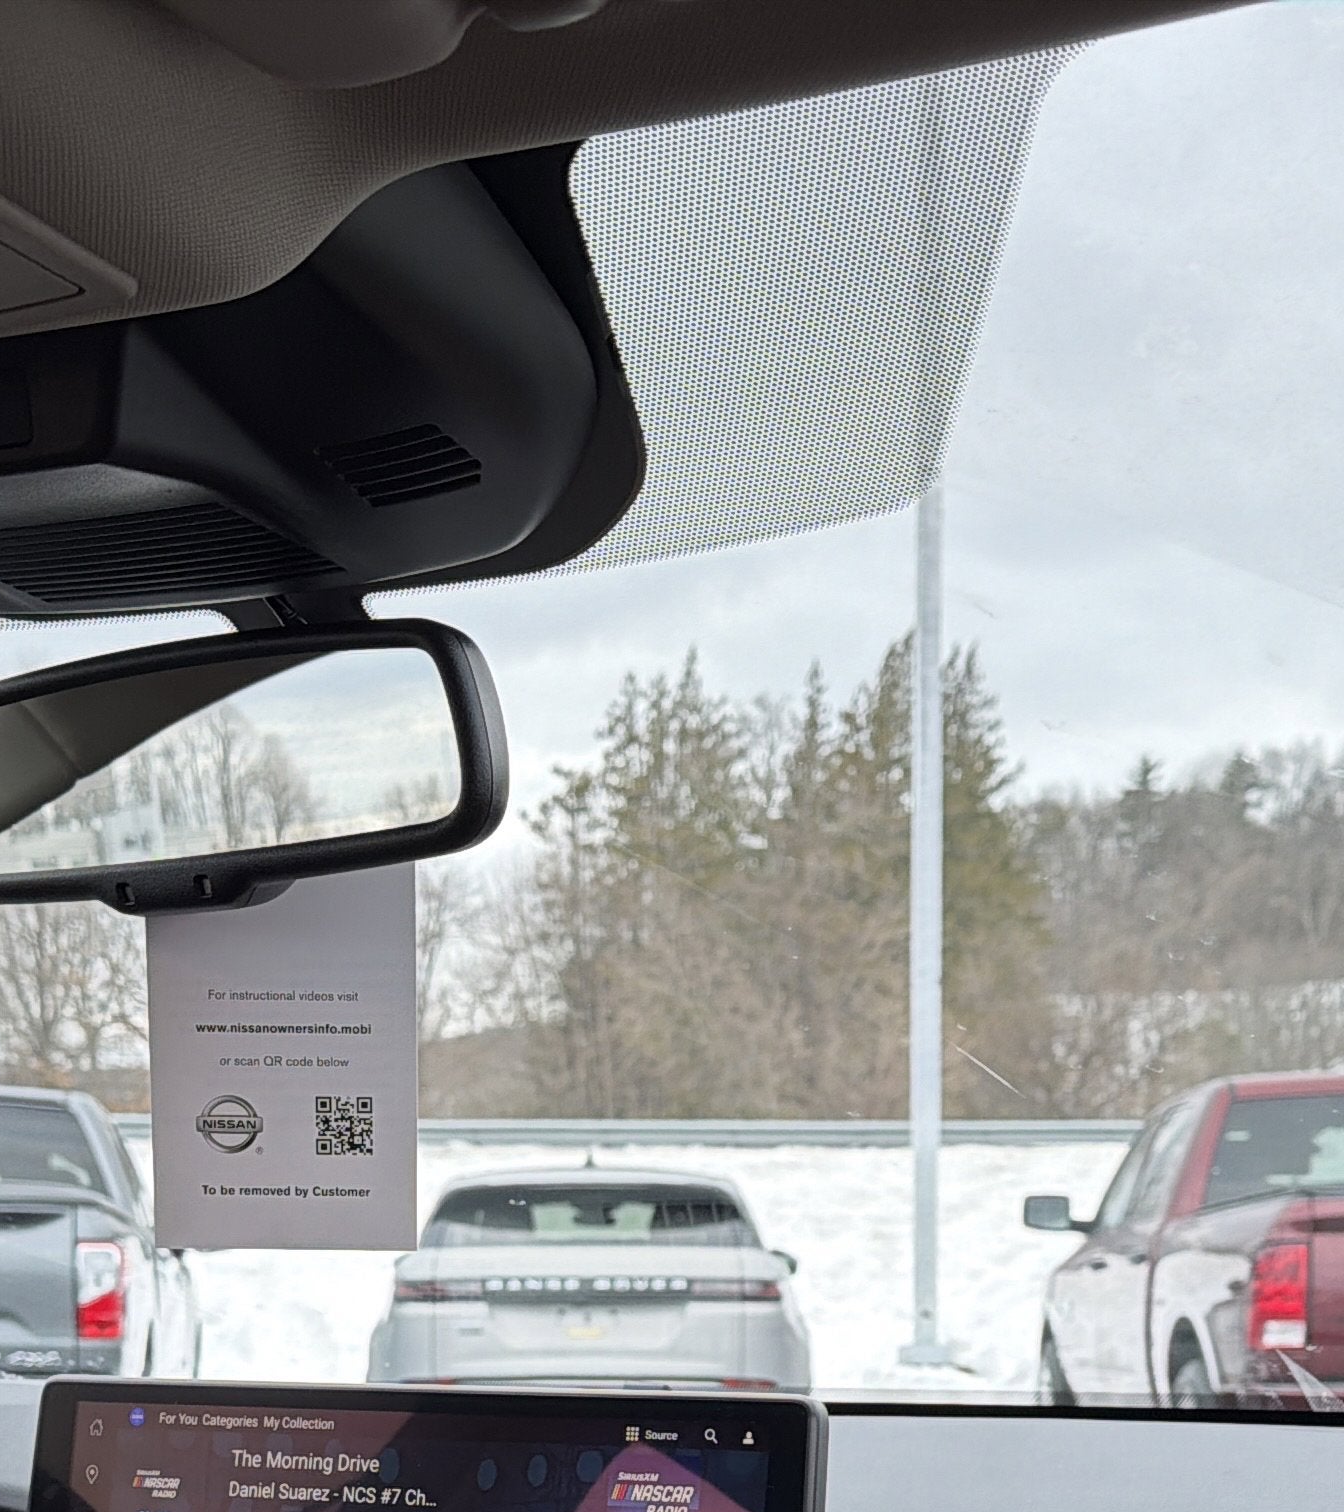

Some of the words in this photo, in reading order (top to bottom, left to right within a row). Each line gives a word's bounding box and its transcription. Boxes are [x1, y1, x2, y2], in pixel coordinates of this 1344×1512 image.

[207, 989, 226, 1001] For
[229, 989, 296, 1001] instructional
[298, 990, 334, 1002] videos
[337, 991, 359, 1002] visit
[195, 1023, 372, 1035] www.nissanownersinfo.mobi
[219, 1056, 231, 1067] or
[234, 1057, 260, 1067] scan
[263, 1055, 283, 1068] QR
[285, 1056, 313, 1067] code
[317, 1056, 349, 1068] below
[202, 1119, 256, 1129] NISSAN
[201, 1185, 217, 1195] To
[220, 1185, 235, 1196] be
[239, 1185, 290, 1197] removed
[294, 1186, 309, 1199] by
[312, 1185, 371, 1198] Customer
[158, 1411, 176, 1425] For
[178, 1411, 198, 1426] You
[201, 1412, 259, 1430] Categories
[263, 1416, 281, 1431] My
[282, 1416, 335, 1431] Collection
[645, 1429, 678, 1442] Source
[232, 1449, 262, 1468] The
[265, 1451, 333, 1475] Morning
[338, 1453, 380, 1473] Drive
[229, 1480, 275, 1499] Daniel
[278, 1484, 330, 1502] Suarez
[342, 1486, 376, 1505] NCS
[381, 1487, 400, 1505] #7
[630, 1484, 694, 1503] NASCAR
